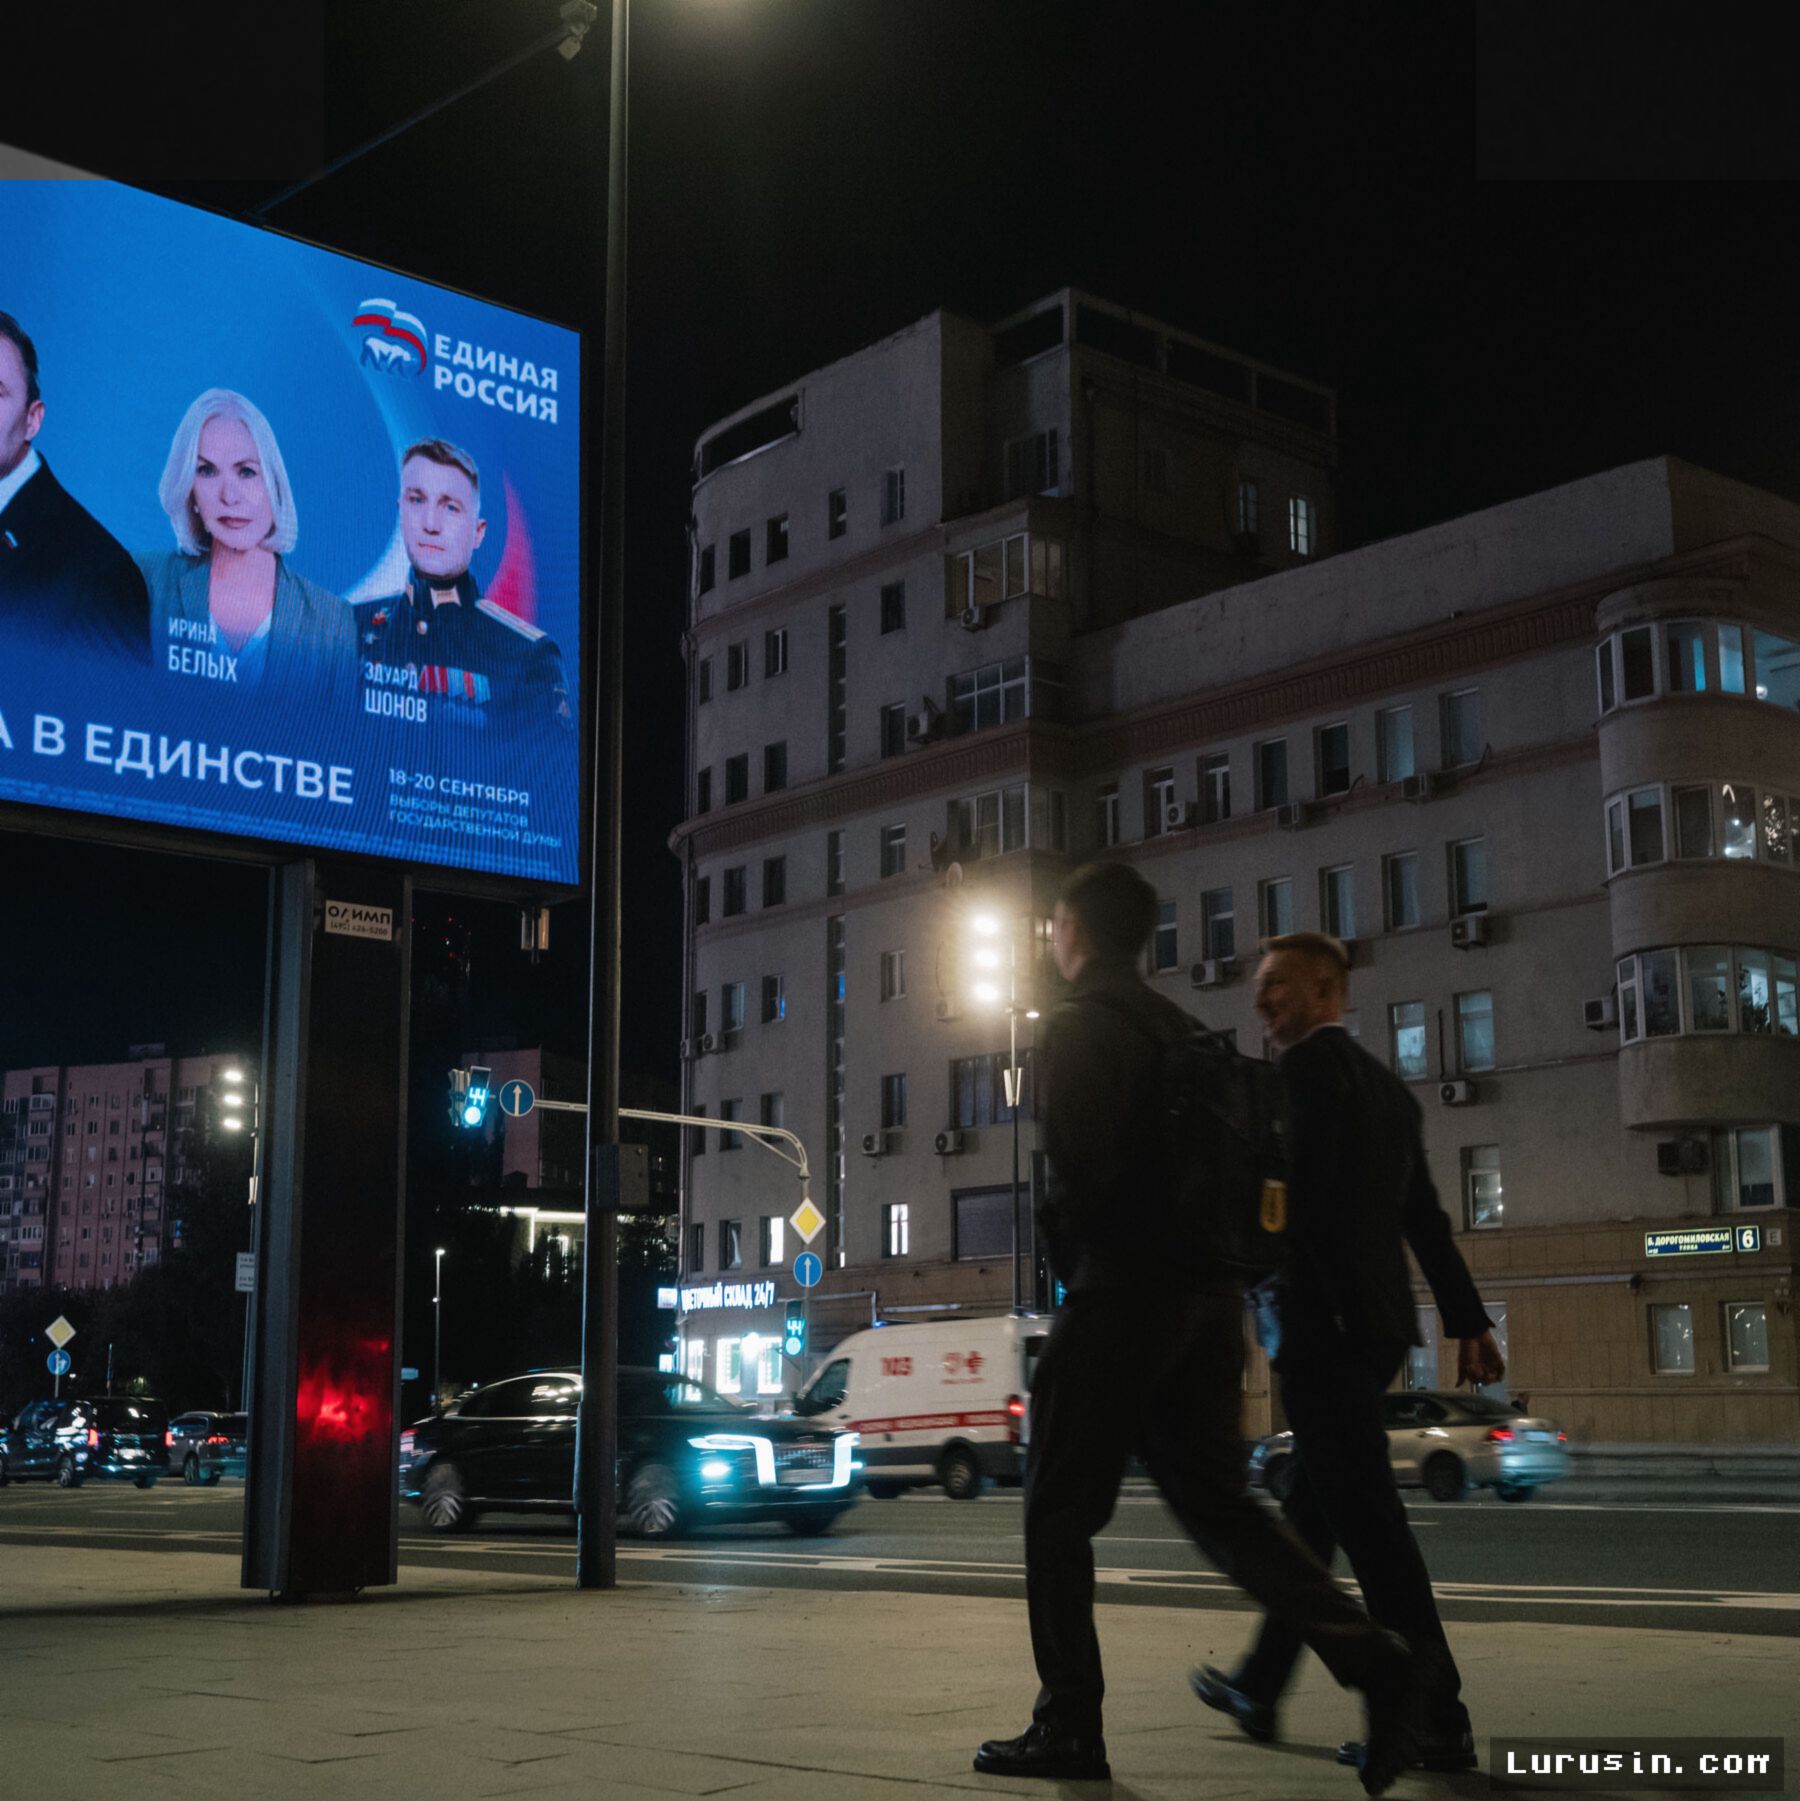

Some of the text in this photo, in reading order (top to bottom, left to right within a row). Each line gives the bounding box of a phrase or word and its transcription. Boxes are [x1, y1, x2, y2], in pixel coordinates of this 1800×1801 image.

[434, 333, 558, 393] ЕДИНАЯ
[434, 364, 558, 424] РОССИЯ
[168, 616, 217, 645] ИРИНА
[168, 644, 238, 683] БЕЛЫХ
[364, 687, 428, 722] ШОНОВ
[33, 713, 66, 756] В
[85, 723, 355, 805] ЕДИНСТВЕ
[389, 768, 530, 806] 18-20 СЕНТЯБРЯ
[389, 793, 529, 828] ВЫБОРЫ ДЕПУТАТОВ
[389, 810, 520, 841] ГОСУДАРСТВЕННОЙ
[521, 831, 562, 849] ДУМЫ
[469, 1087, 487, 1107] 44
[1655, 1232, 1730, 1247] ДОРОГОМИЛОВСКАЯ
[1742, 1229, 1755, 1249] 6
[754, 1280, 776, 1309] 24/7
[786, 1319, 802, 1336] 44
